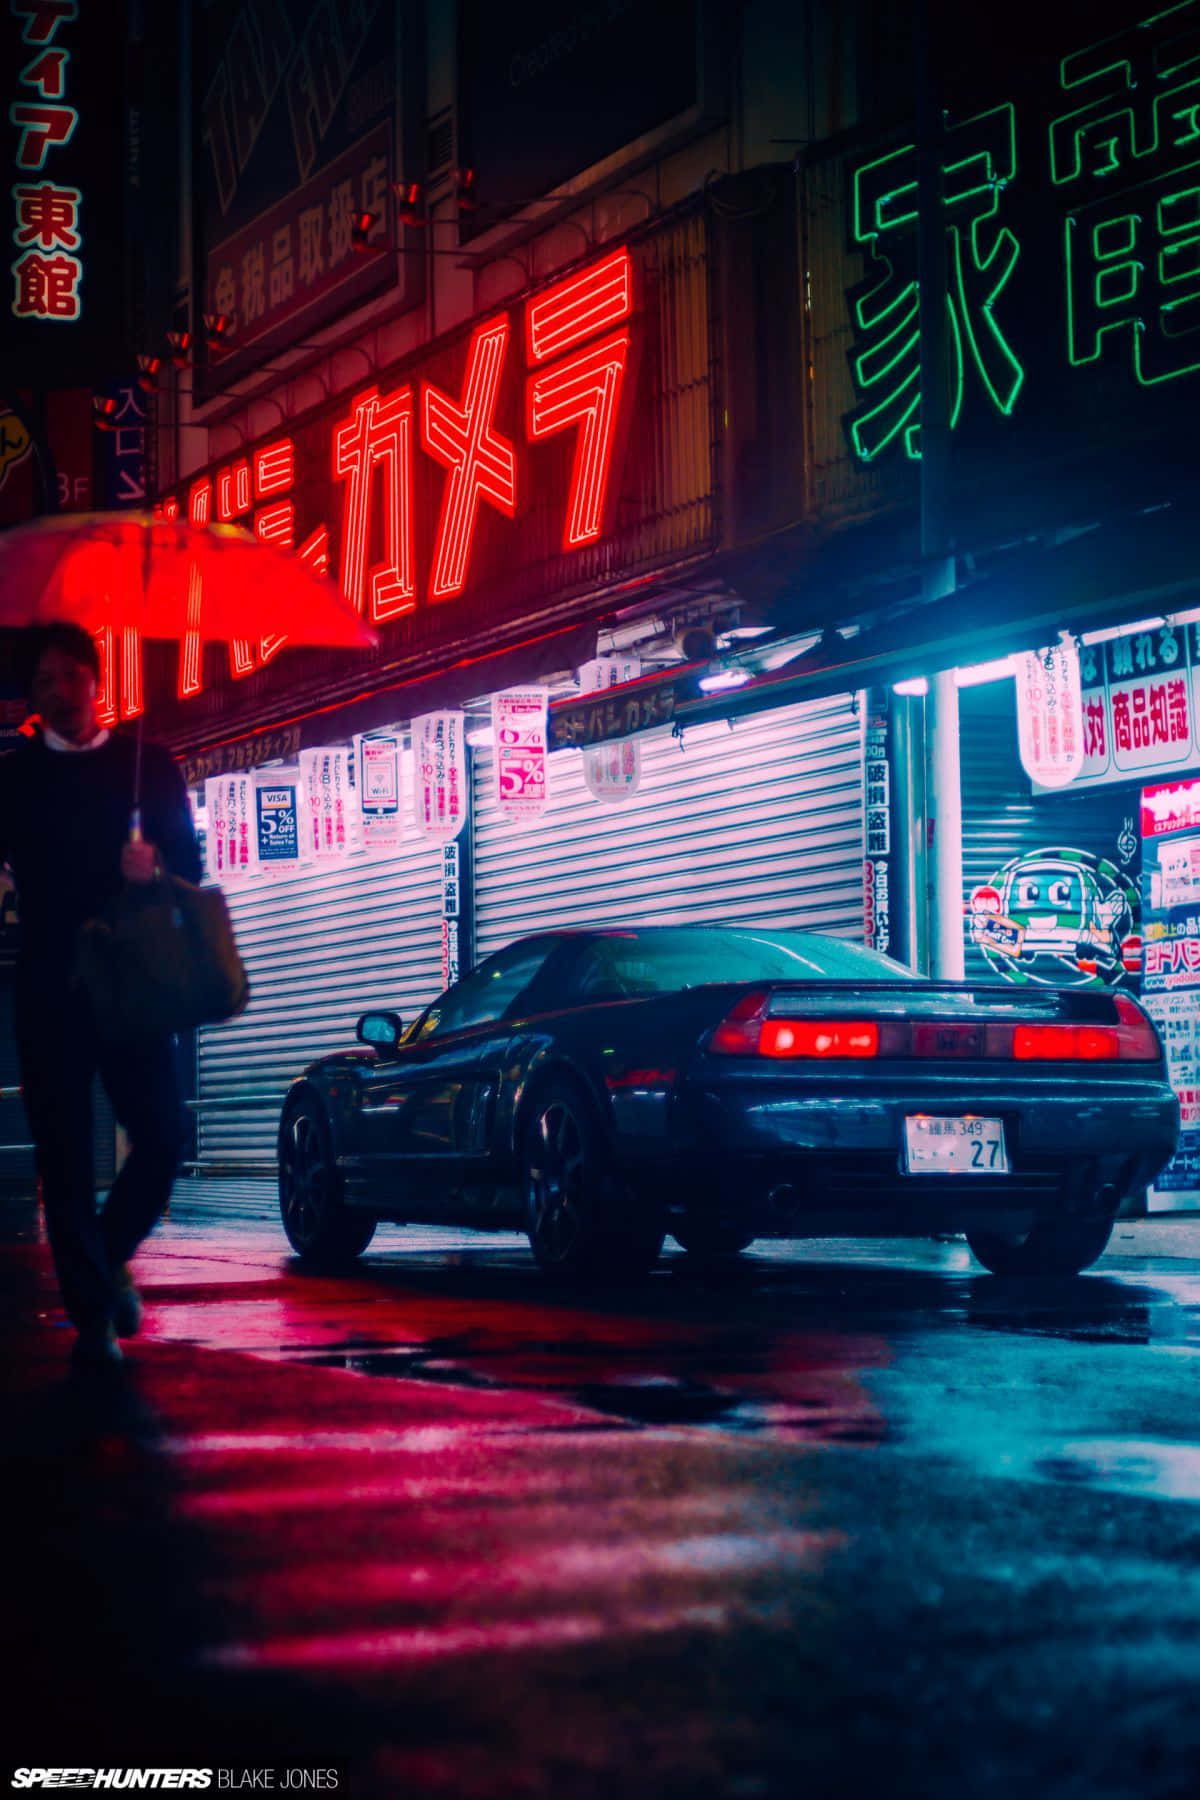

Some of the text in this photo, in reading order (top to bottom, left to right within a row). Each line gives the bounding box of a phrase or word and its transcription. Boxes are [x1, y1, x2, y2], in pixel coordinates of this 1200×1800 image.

[1112, 678, 1189, 752] 商品知識
[266, 794, 288, 803] VISA
[260, 809, 295, 834] 5%
[278, 825, 295, 834] OFF
[959, 1121, 983, 1136] 349
[971, 1139, 1001, 1168] 27
